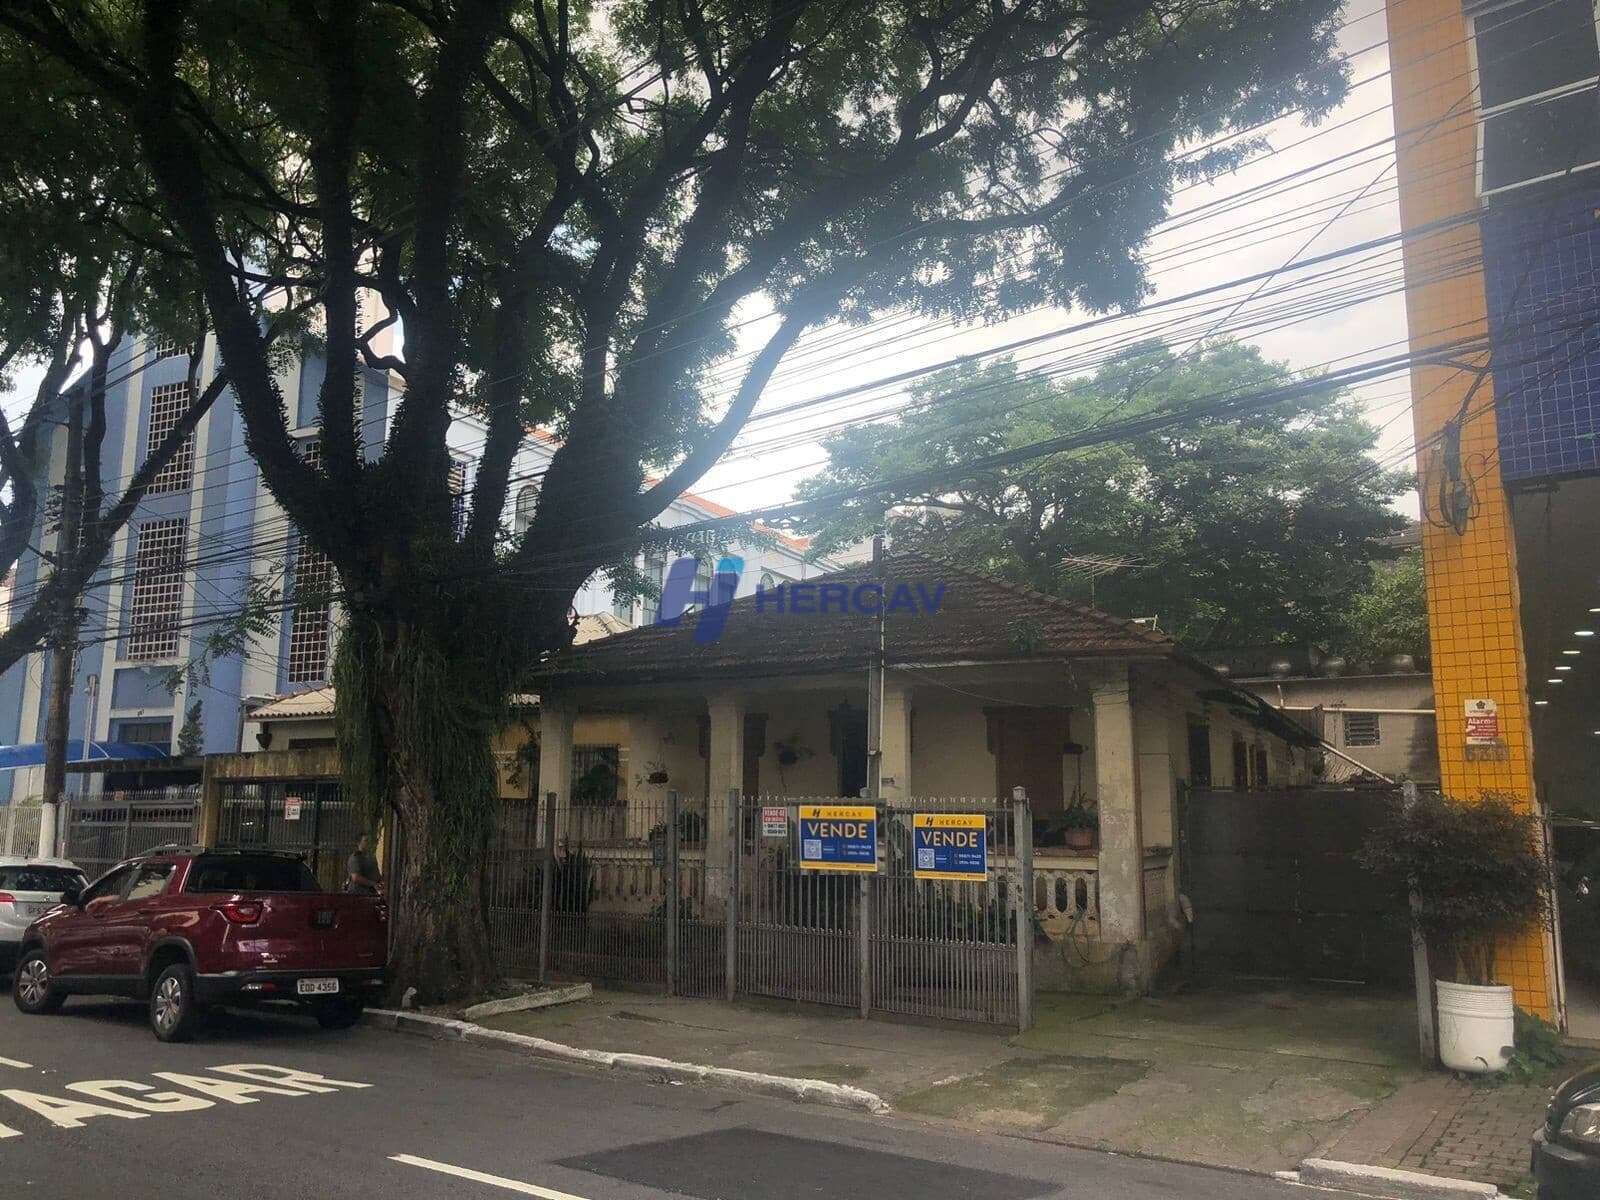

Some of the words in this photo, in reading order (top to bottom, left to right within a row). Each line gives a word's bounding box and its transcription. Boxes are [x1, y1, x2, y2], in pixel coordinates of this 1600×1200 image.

[808, 822, 868, 839] VENDE
[921, 831, 978, 848] VENDE
[0, 1064, 374, 1139] AGAR
